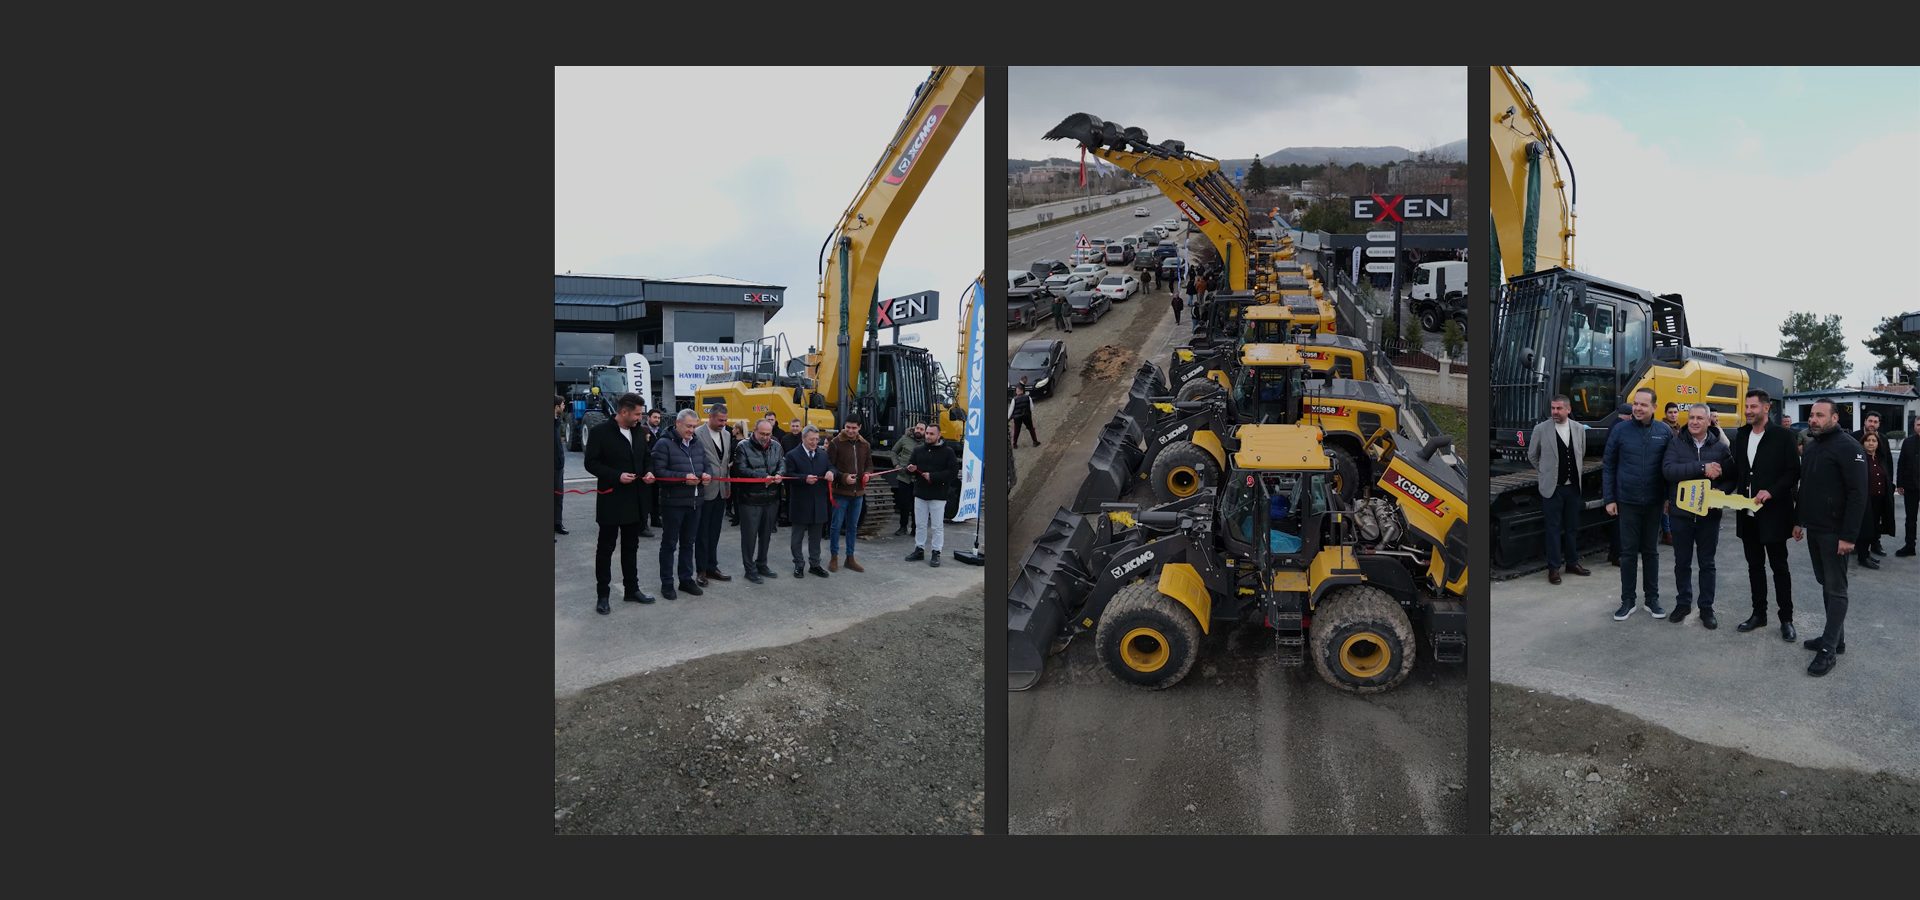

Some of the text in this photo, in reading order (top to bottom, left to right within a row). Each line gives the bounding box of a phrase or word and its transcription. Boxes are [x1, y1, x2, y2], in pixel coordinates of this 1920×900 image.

[908, 115, 936, 160] XCMG
[1354, 194, 1448, 224] EXEN
[744, 292, 778, 302] EXEN
[877, 295, 925, 326] XEN
[1676, 385, 1698, 394] EXEN
[1312, 405, 1336, 414] XC958
[1166, 424, 1188, 440] XCMG
[1394, 475, 1430, 503] XC958
[1122, 550, 1154, 574] XCMG
